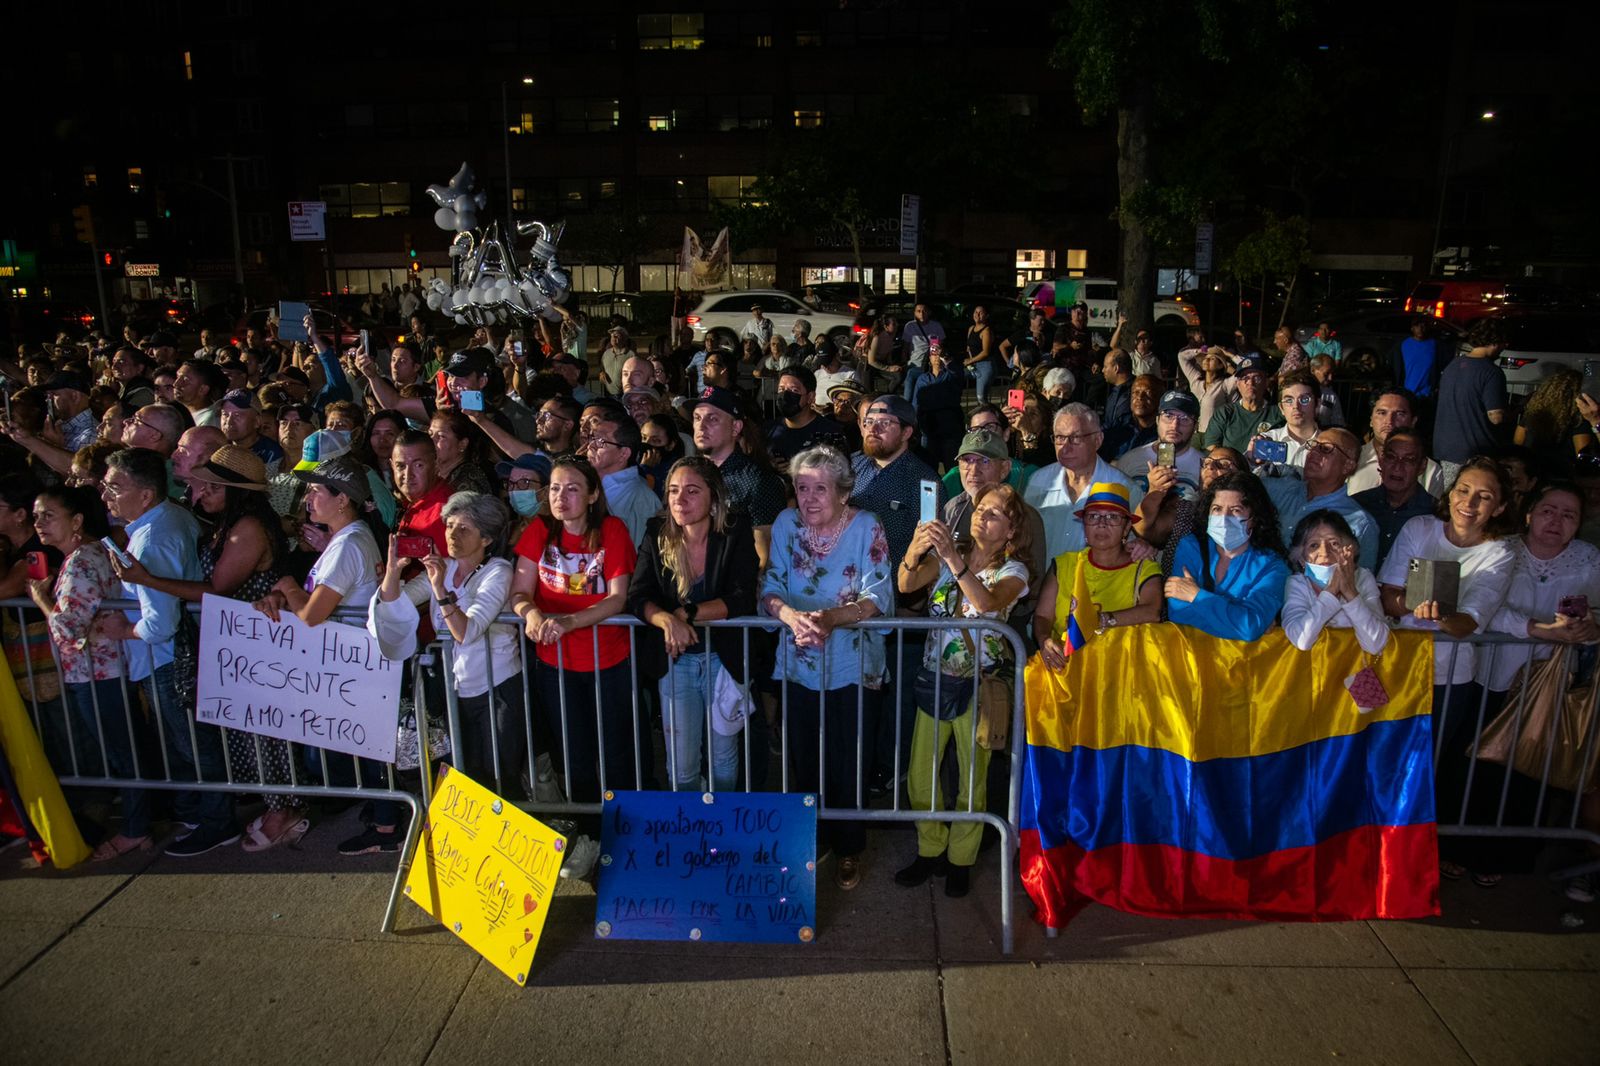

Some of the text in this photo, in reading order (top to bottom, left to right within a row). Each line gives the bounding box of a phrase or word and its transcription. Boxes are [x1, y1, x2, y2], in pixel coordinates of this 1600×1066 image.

[327, 467, 354, 481] York
[203, 696, 236, 721] TE
[439, 784, 557, 880] DESDE BOSTON
[643, 805, 724, 843] apostamos
[732, 807, 782, 834] TODO
[655, 842, 671, 868] el
[680, 840, 741, 879] gobierno
[752, 841, 782, 865] del
[613, 896, 676, 919] PACTO
[768, 903, 809, 922] VIDA
